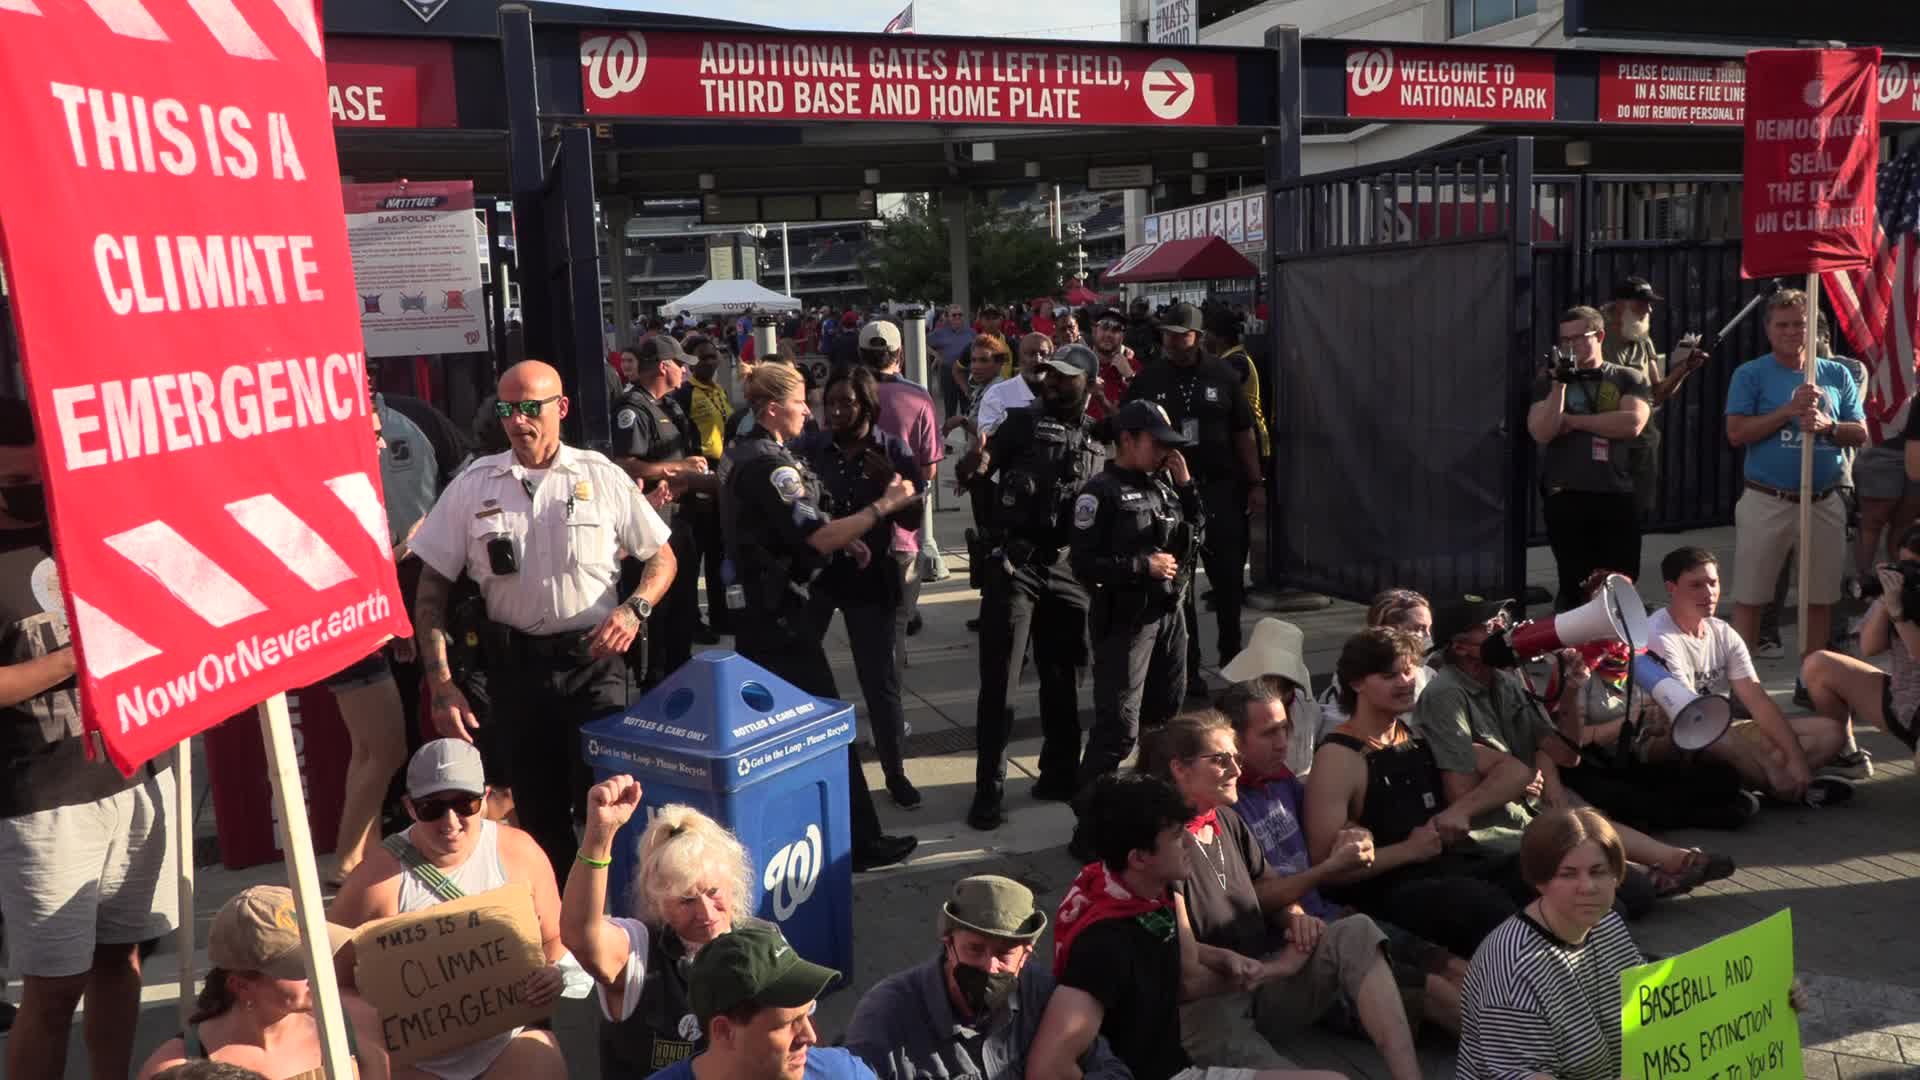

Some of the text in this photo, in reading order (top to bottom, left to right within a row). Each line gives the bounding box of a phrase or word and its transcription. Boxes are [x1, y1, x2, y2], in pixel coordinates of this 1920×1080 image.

[700, 42, 1129, 90] ADDITIONAL GATES AT LEFT FIELD,
[1401, 60, 1515, 85] WELCOME TO
[1618, 64, 1658, 80] PLEASE
[1661, 65, 1713, 82] CONTINUE
[329, 85, 386, 120] ASE
[700, 79, 1081, 118] THIRD BASE AND HOME PLATE
[1401, 85, 1547, 109] NATIONALS PARK
[1635, 83, 1745, 102] IN A SINGLE FILE LINE
[1618, 104, 1630, 118] DO
[1633, 105, 1650, 118] NOT
[1652, 106, 1688, 119] REMOVE
[1691, 106, 1735, 120] PERSONAL
[50, 81, 306, 181] THIS IS A
[1789, 152, 1839, 175] SEAL
[1767, 181, 1806, 204] THE
[378, 214, 437, 224] BAG POLICY
[1755, 211, 1778, 233] ON
[94, 233, 325, 315] CLIMATE
[722, 302, 758, 310] TOYOTA
[52, 352, 367, 471] EMERGENCY
[115, 588, 390, 734] NowOrNever.earth
[623, 716, 709, 741] BOTTLES & CANS ONLY
[731, 719, 768, 738] BOTTLES
[775, 708, 797, 721] CANS
[796, 702, 816, 715] ONLY
[750, 754, 764, 768] Get
[765, 753, 772, 764] in
[773, 749, 785, 761] the
[784, 742, 802, 755] Loop
[806, 733, 826, 746] Please
[826, 722, 849, 738] Recycle
[376, 911, 481, 949] THIS IS A
[400, 937, 510, 999] CLIMATE
[1639, 955, 1753, 1026] BASEBALL AND
[382, 971, 536, 1052] EMERGENC
[656, 1043, 691, 1059] HONOR
[1643, 999, 1773, 1080] MASS EXTINCTION
[1745, 1052, 1766, 1079] YOU
[1768, 1040, 1784, 1069] BY
